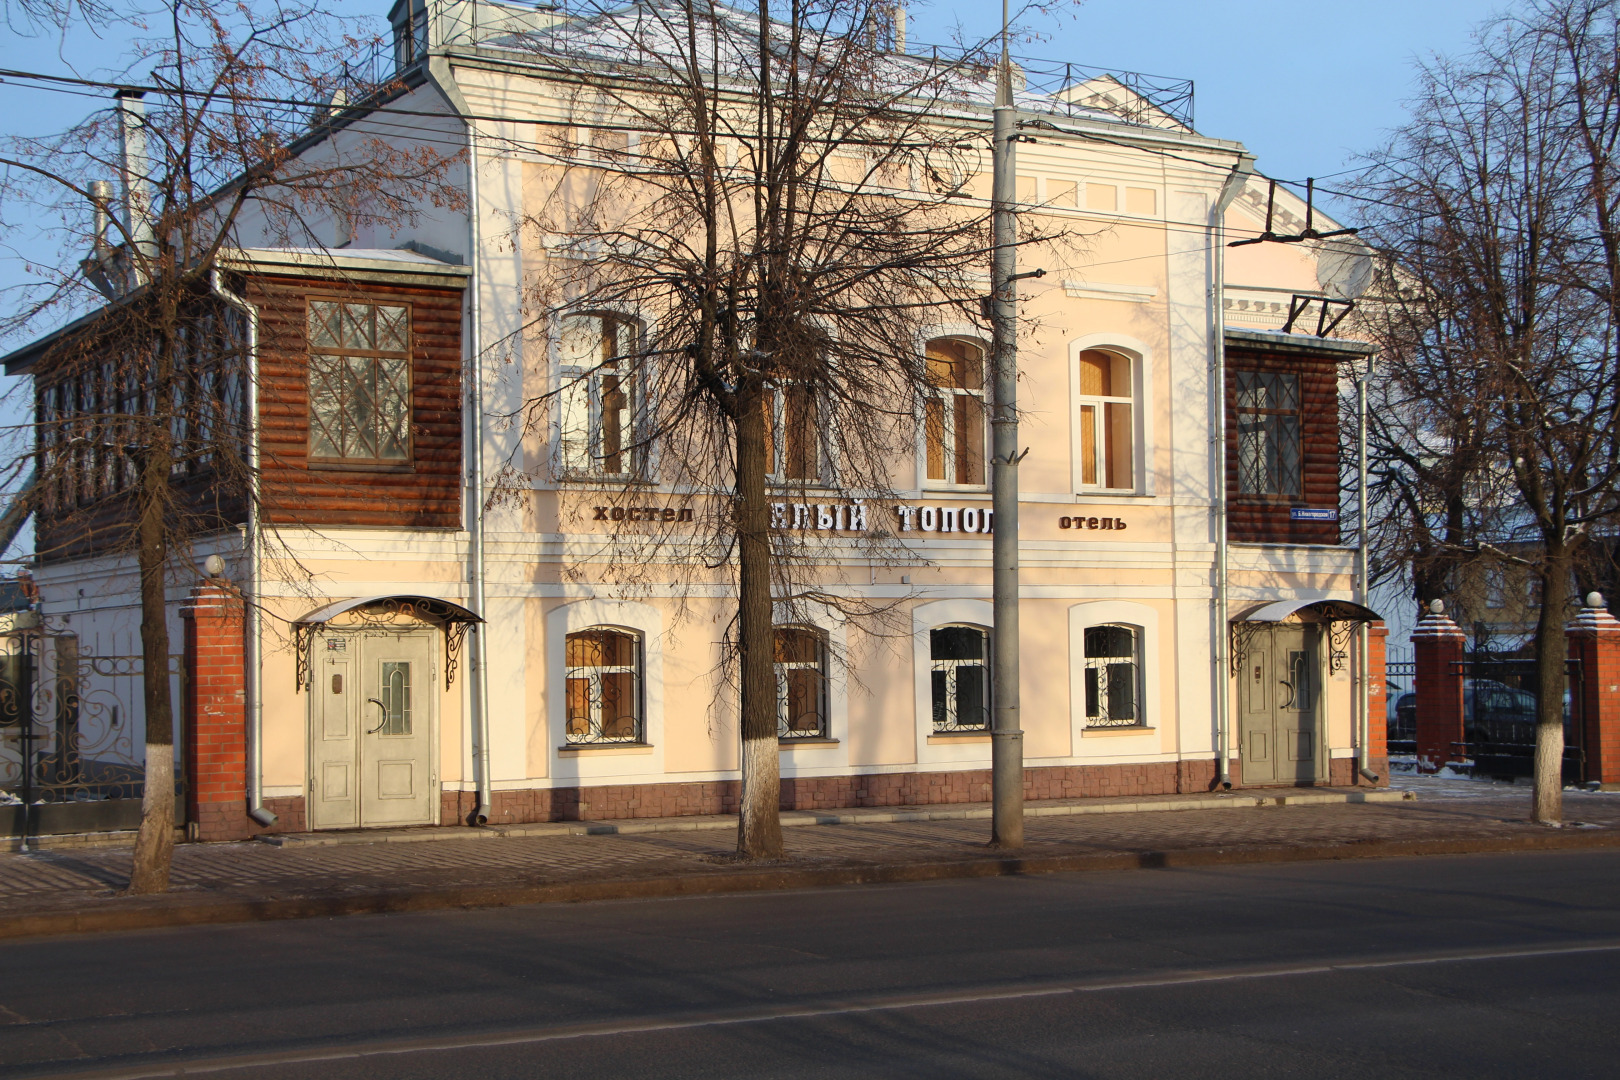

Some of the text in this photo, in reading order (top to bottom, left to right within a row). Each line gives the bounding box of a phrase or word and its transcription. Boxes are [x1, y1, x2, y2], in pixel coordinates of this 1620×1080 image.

[592, 506, 693, 522] хостел
[770, 498, 1020, 535] ЕЛЫЙ ТОПОЛ
[1058, 515, 1128, 531] отель
